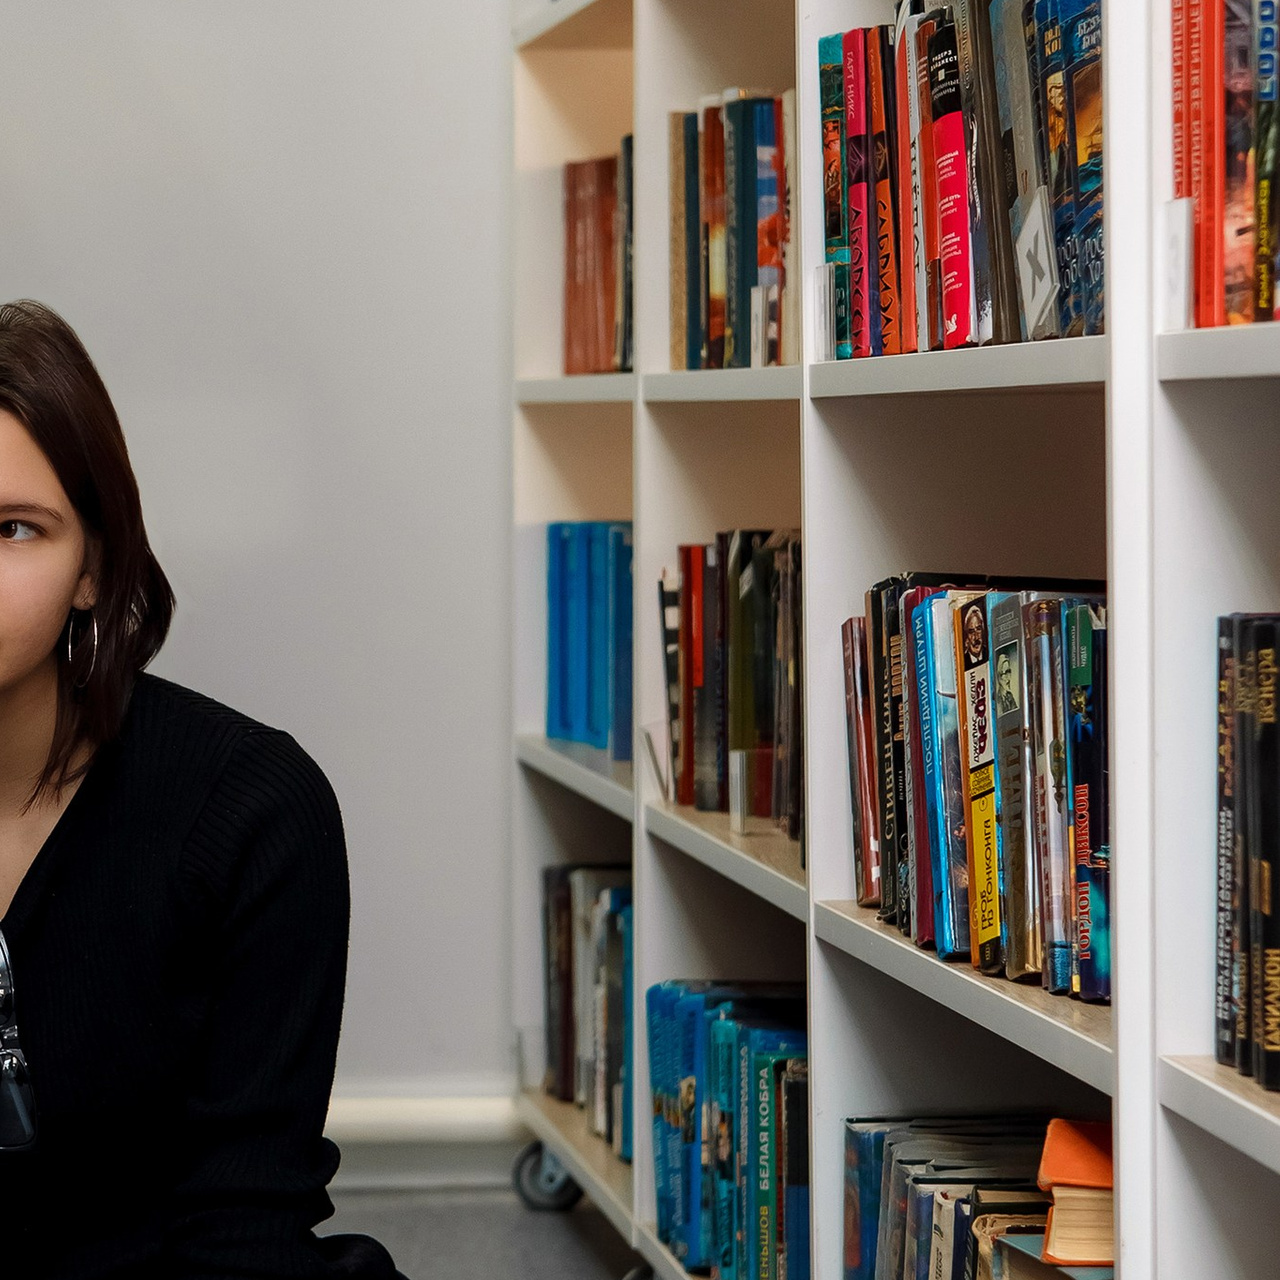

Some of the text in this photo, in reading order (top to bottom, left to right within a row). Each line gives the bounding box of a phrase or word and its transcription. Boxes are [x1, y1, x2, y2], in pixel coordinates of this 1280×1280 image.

[847, 51, 856, 120] ГАРТ НИКС
[1173, 123, 1184, 198] СИЛИЙ
[915, 616, 933, 775] ПОСЛЕДНИЙ ШТУРМ
[884, 742, 895, 840] СТИВЕН
[983, 819, 994, 928] ИЗ ГОНКОНГА
[1074, 783, 1092, 960] ГОРДОН ДИКСОН
[980, 891, 988, 931] ГРОБ
[759, 1066, 770, 1127] КОБРА
[759, 1131, 770, 1190] БЕЛАЯ
